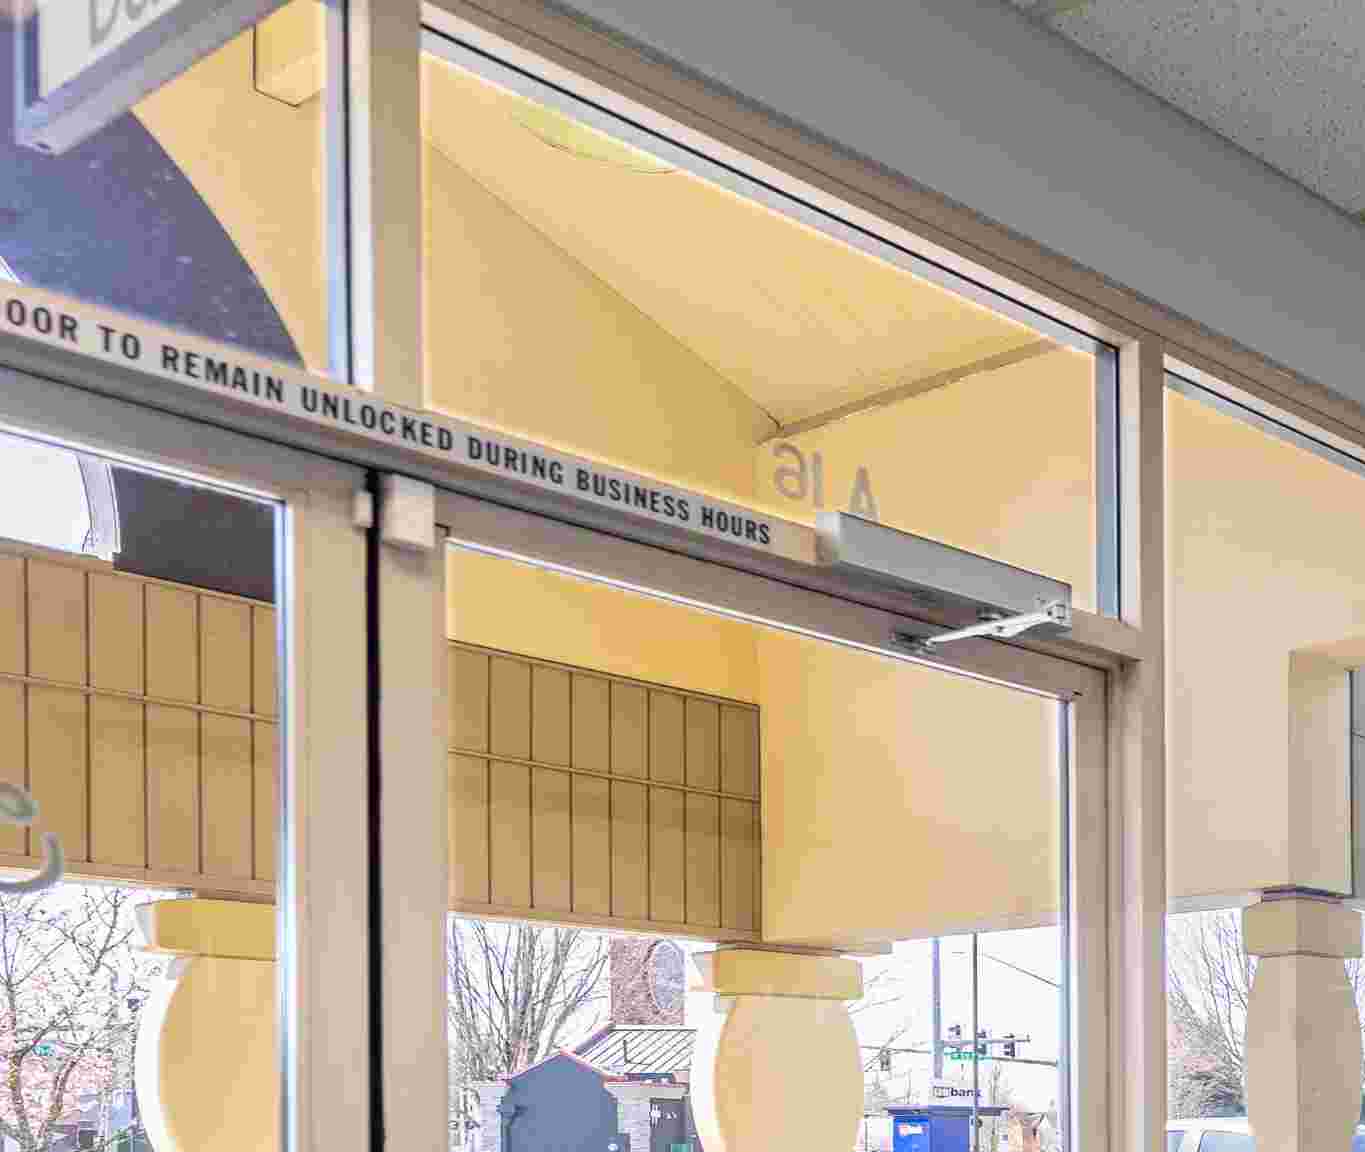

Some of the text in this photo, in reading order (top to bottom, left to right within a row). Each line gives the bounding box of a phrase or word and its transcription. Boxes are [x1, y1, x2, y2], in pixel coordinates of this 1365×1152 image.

[0, 297, 771, 545] OOR TO REMAIN UNLOCKED DURING BUSINESS HOURS
